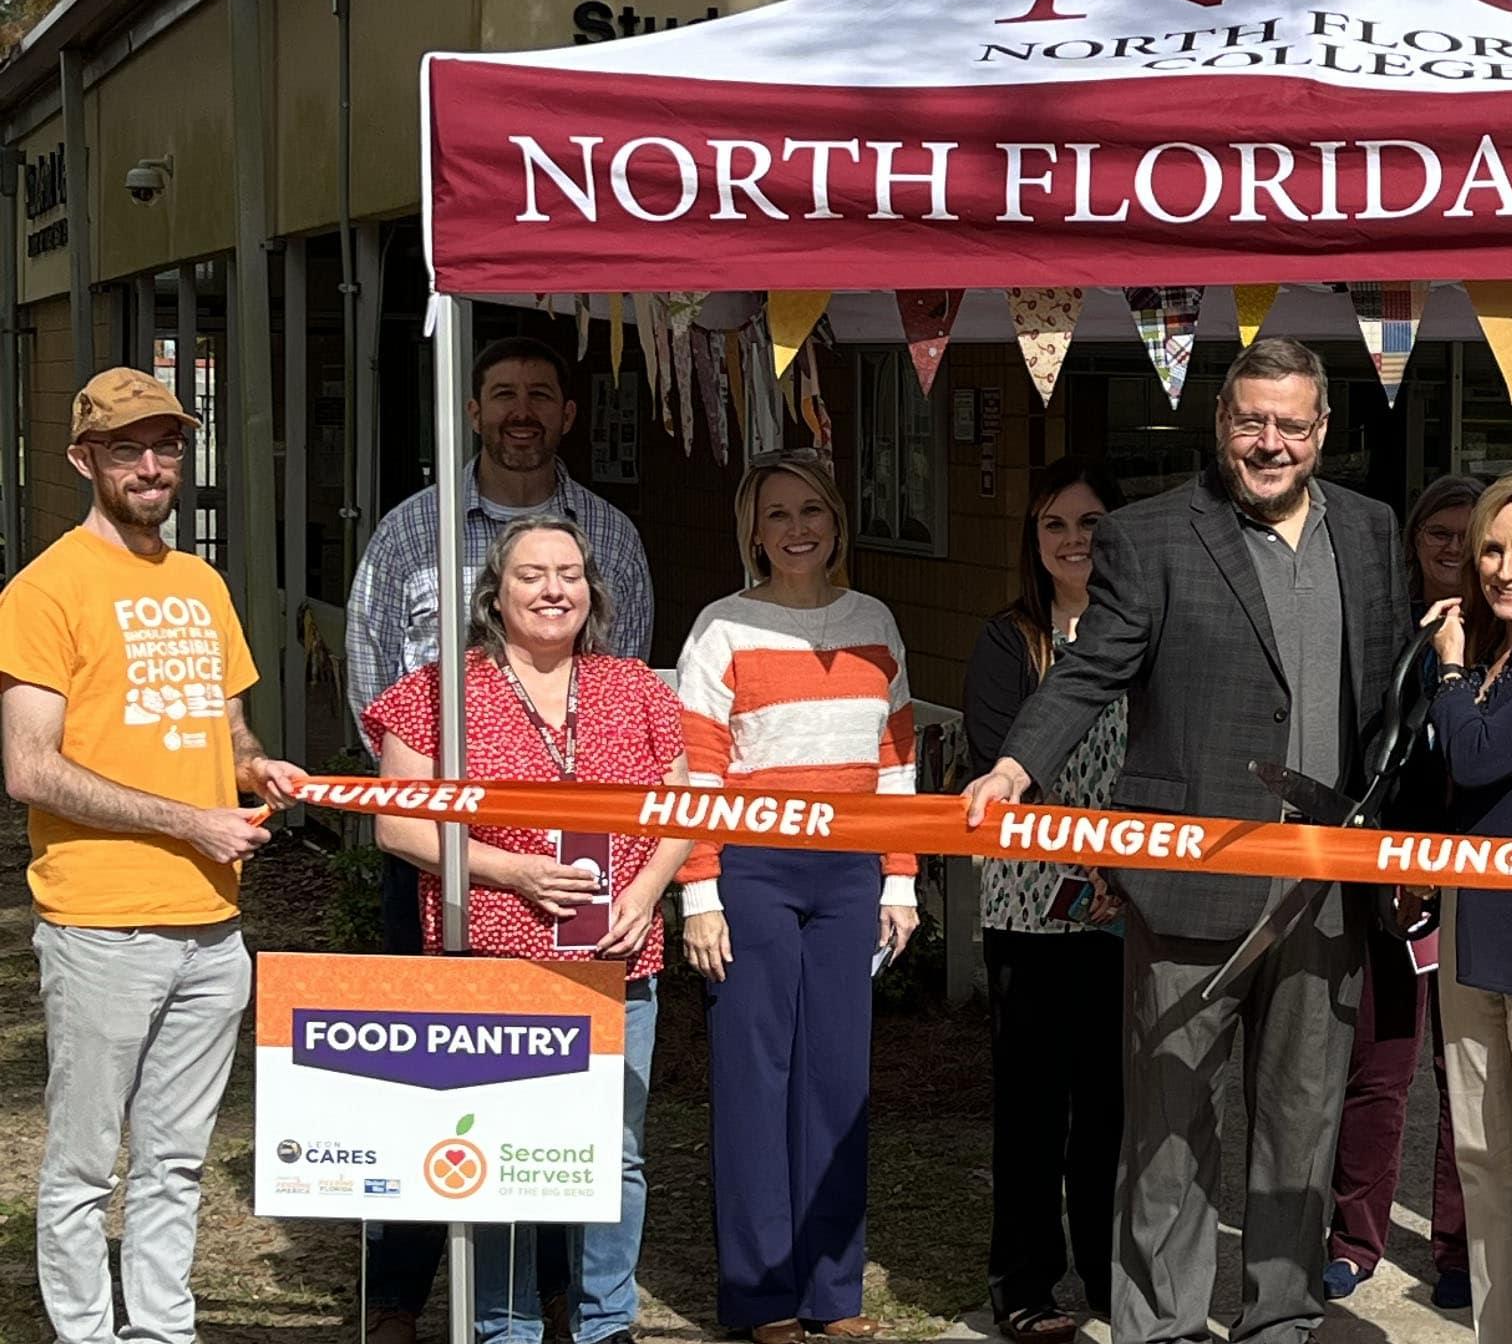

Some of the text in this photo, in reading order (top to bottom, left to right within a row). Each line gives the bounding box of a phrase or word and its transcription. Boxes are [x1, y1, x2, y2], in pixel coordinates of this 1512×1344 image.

[979, 17, 1283, 63] NORTH
[508, 134, 960, 223] NORTH
[114, 596, 212, 630] FOOD
[124, 639, 222, 660] IMPOSSIBLE
[127, 656, 224, 685] CHOICE
[638, 790, 835, 837] HUNGER
[999, 811, 1205, 860] HUNGER
[305, 1021, 580, 1056] FOOD PANTRY
[305, 1149, 377, 1165] CARES
[499, 1143, 595, 1163] Second
[499, 1165, 595, 1184] Harvest
